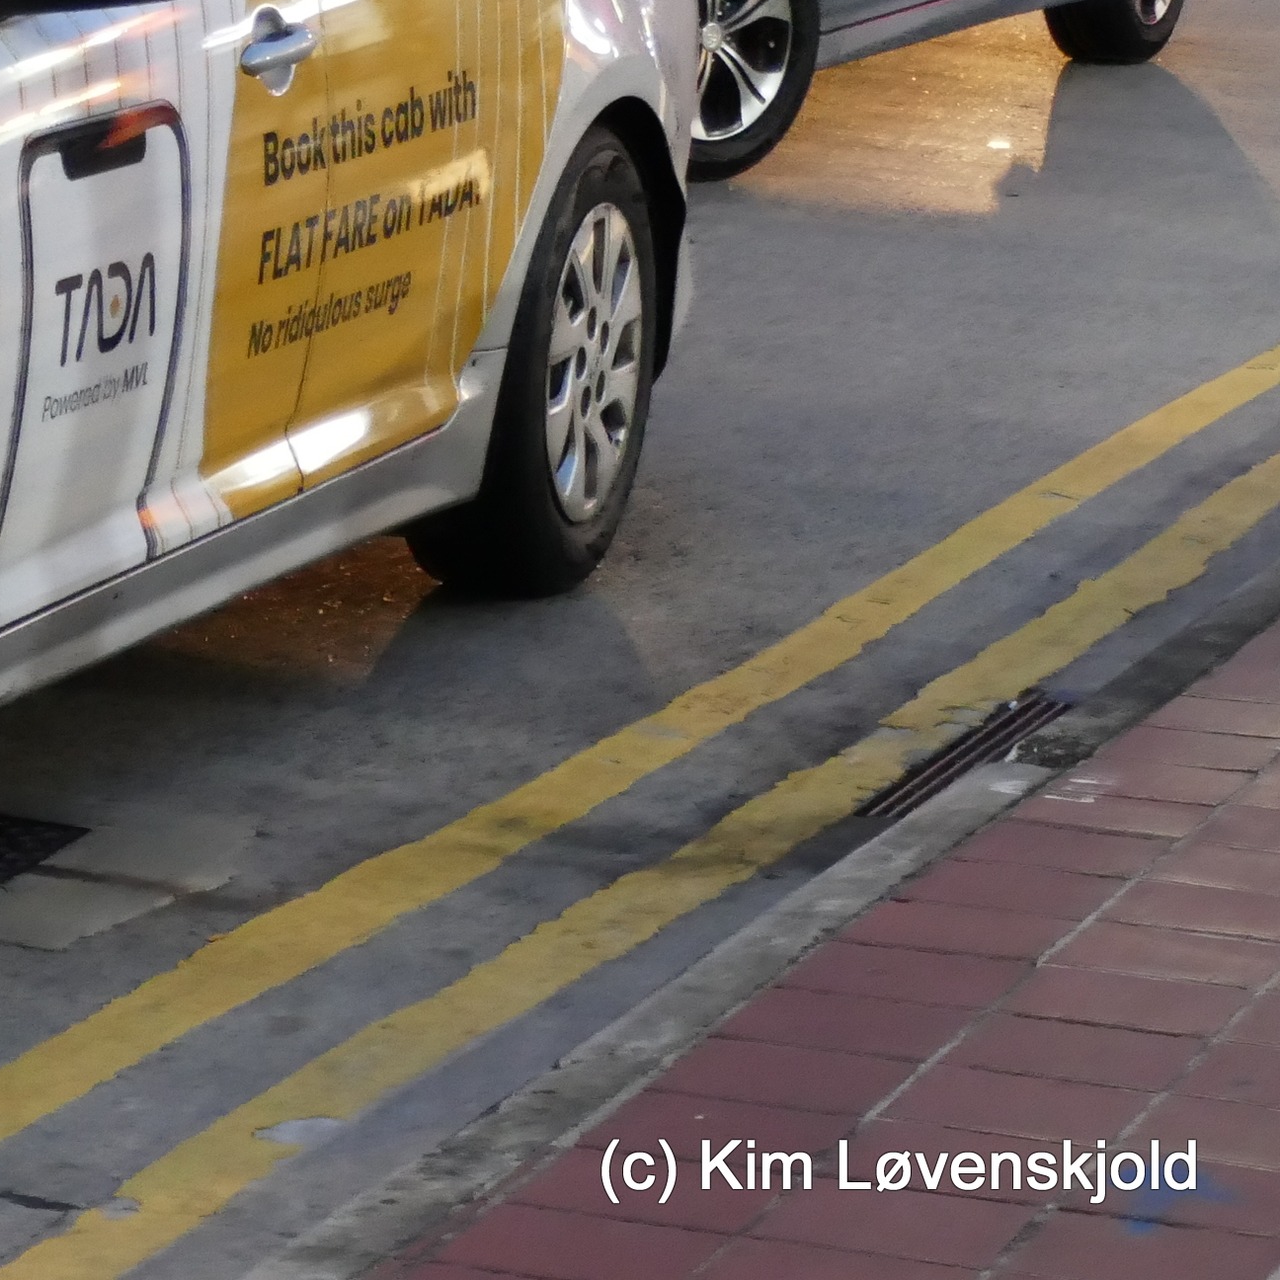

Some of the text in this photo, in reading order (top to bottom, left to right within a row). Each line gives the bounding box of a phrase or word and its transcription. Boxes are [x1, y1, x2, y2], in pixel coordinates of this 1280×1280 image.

[263, 70, 478, 186] Book this cab with
[258, 214, 320, 284] FLAT
[320, 194, 381, 264] FARE
[382, 194, 413, 239] on
[55, 252, 156, 367] TADA
[247, 322, 272, 359] No
[364, 271, 412, 315] surge
[42, 381, 102, 422] Powered
